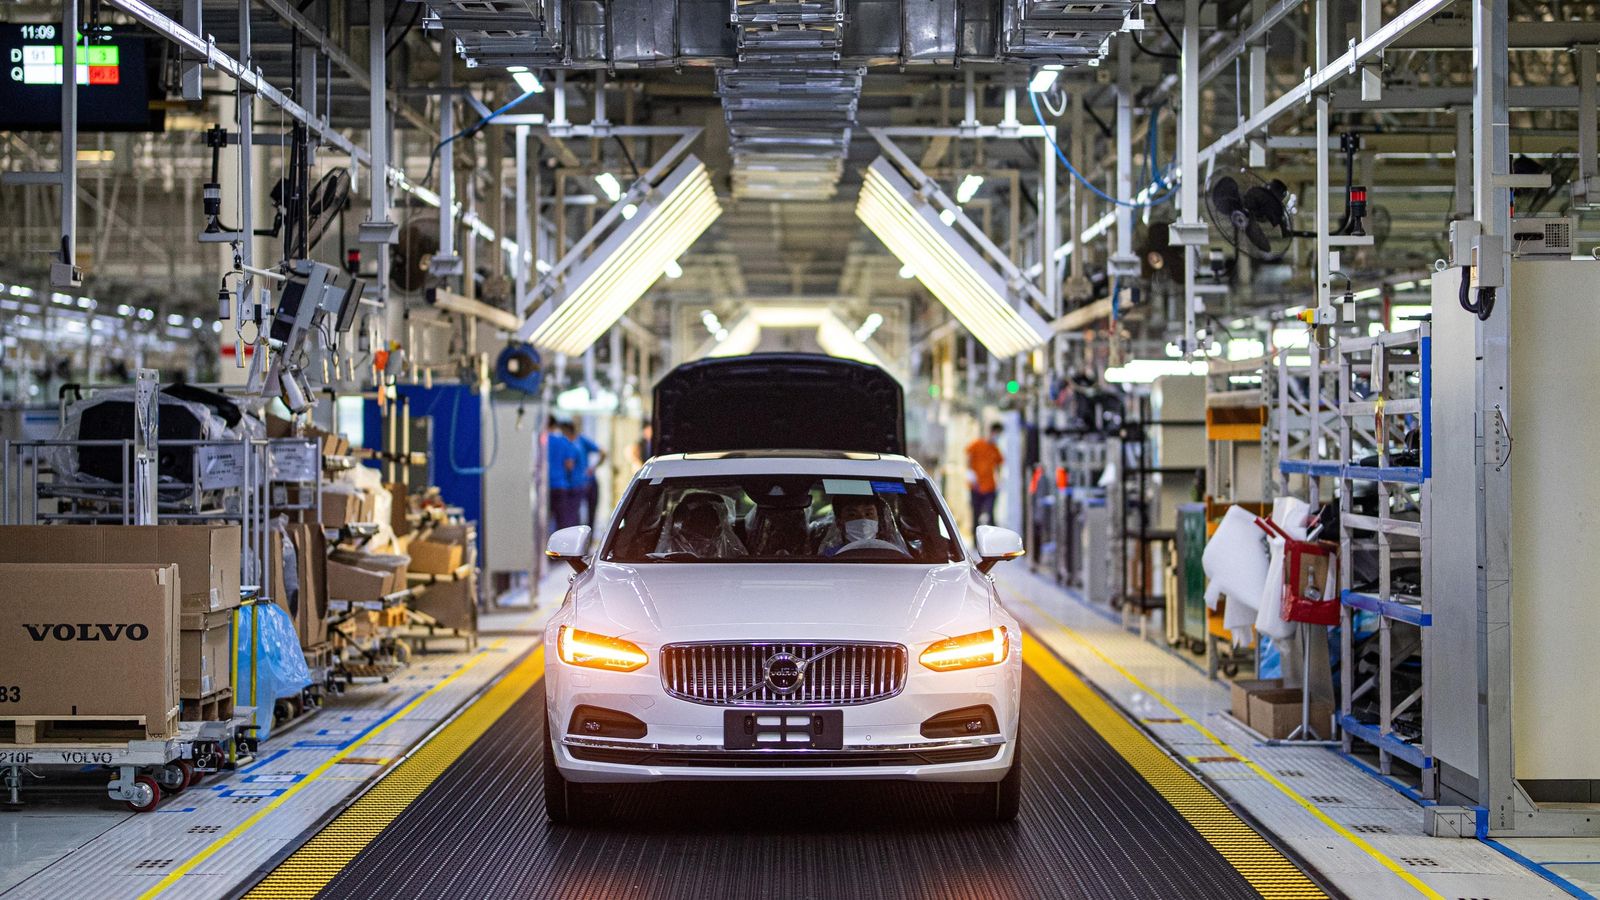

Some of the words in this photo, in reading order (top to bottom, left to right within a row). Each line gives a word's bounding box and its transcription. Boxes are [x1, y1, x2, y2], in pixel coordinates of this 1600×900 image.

[21, 25, 55, 39] 11:09
[11, 48, 22, 63] D
[11, 66, 23, 81] Q
[22, 623, 149, 641] VOLVO
[61, 752, 113, 764] VOLVO
